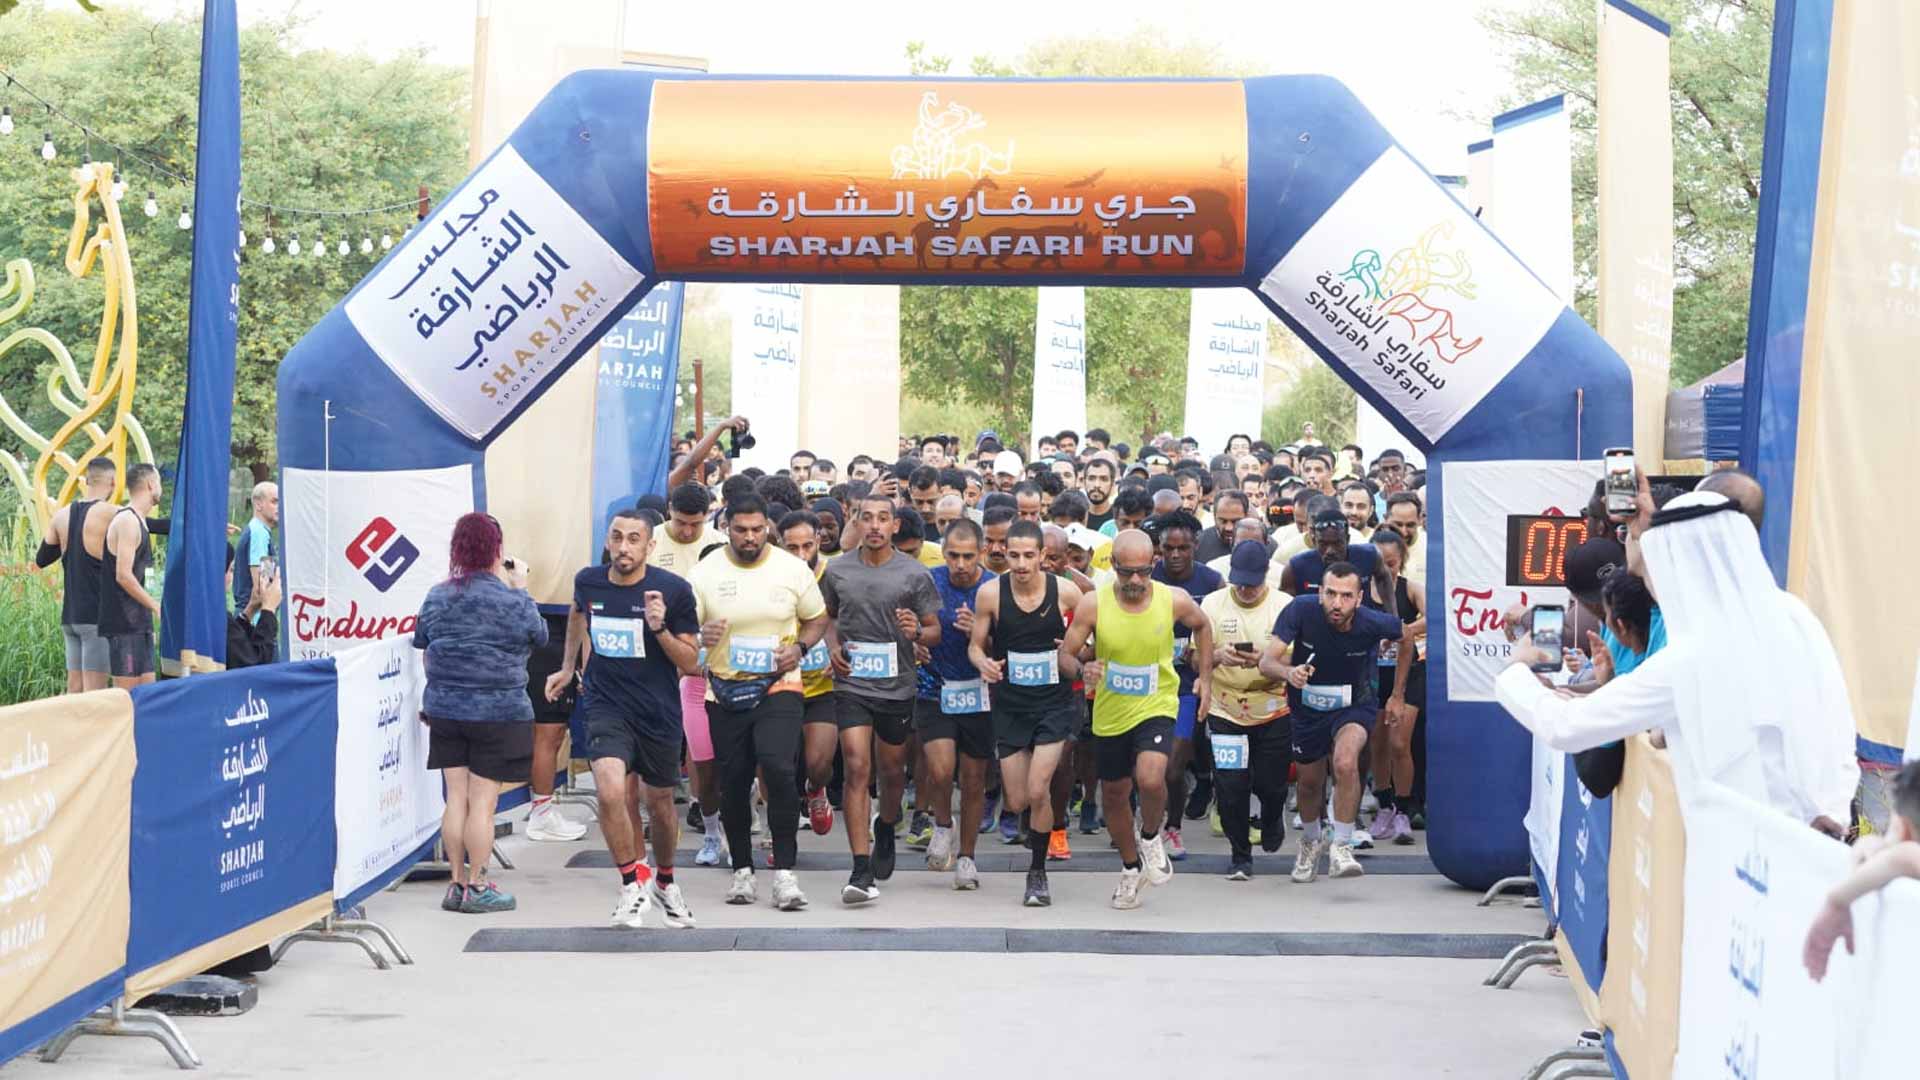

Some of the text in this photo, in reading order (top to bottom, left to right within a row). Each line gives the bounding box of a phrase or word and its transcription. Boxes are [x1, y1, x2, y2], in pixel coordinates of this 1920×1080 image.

[707, 185, 1196, 229] جري سفاري الشارقة
[387, 188, 500, 300] مجلس
[709, 233, 1195, 258] SHARJAH SAFARI RUN
[409, 210, 536, 340] الشارقة
[454, 242, 571, 371] الرياضي
[480, 280, 598, 399] SHARJAH
[601, 328, 666, 358] الرياض
[1305, 290, 1428, 401] Sharjah Safari
[1316, 269, 1446, 391] سفاري الشارقة
[496, 360, 545, 406] SPORTS
[550, 296, 608, 354] COUNCIL
[599, 361, 664, 381] ARJAH
[292, 593, 418, 642] Endura
[597, 632, 629, 651] 624
[736, 651, 767, 667] 572
[1463, 642, 1512, 658] SPOR
[854, 656, 884, 672] 540
[1014, 665, 1044, 680] 541
[1112, 675, 1144, 691] 603
[224, 688, 270, 730] مجلس
[949, 691, 976, 708] 536
[1307, 695, 1336, 709] 627
[222, 736, 269, 786] الشارقة
[222, 783, 265, 839] الرياضي
[220, 839, 264, 875] SHARJAH
